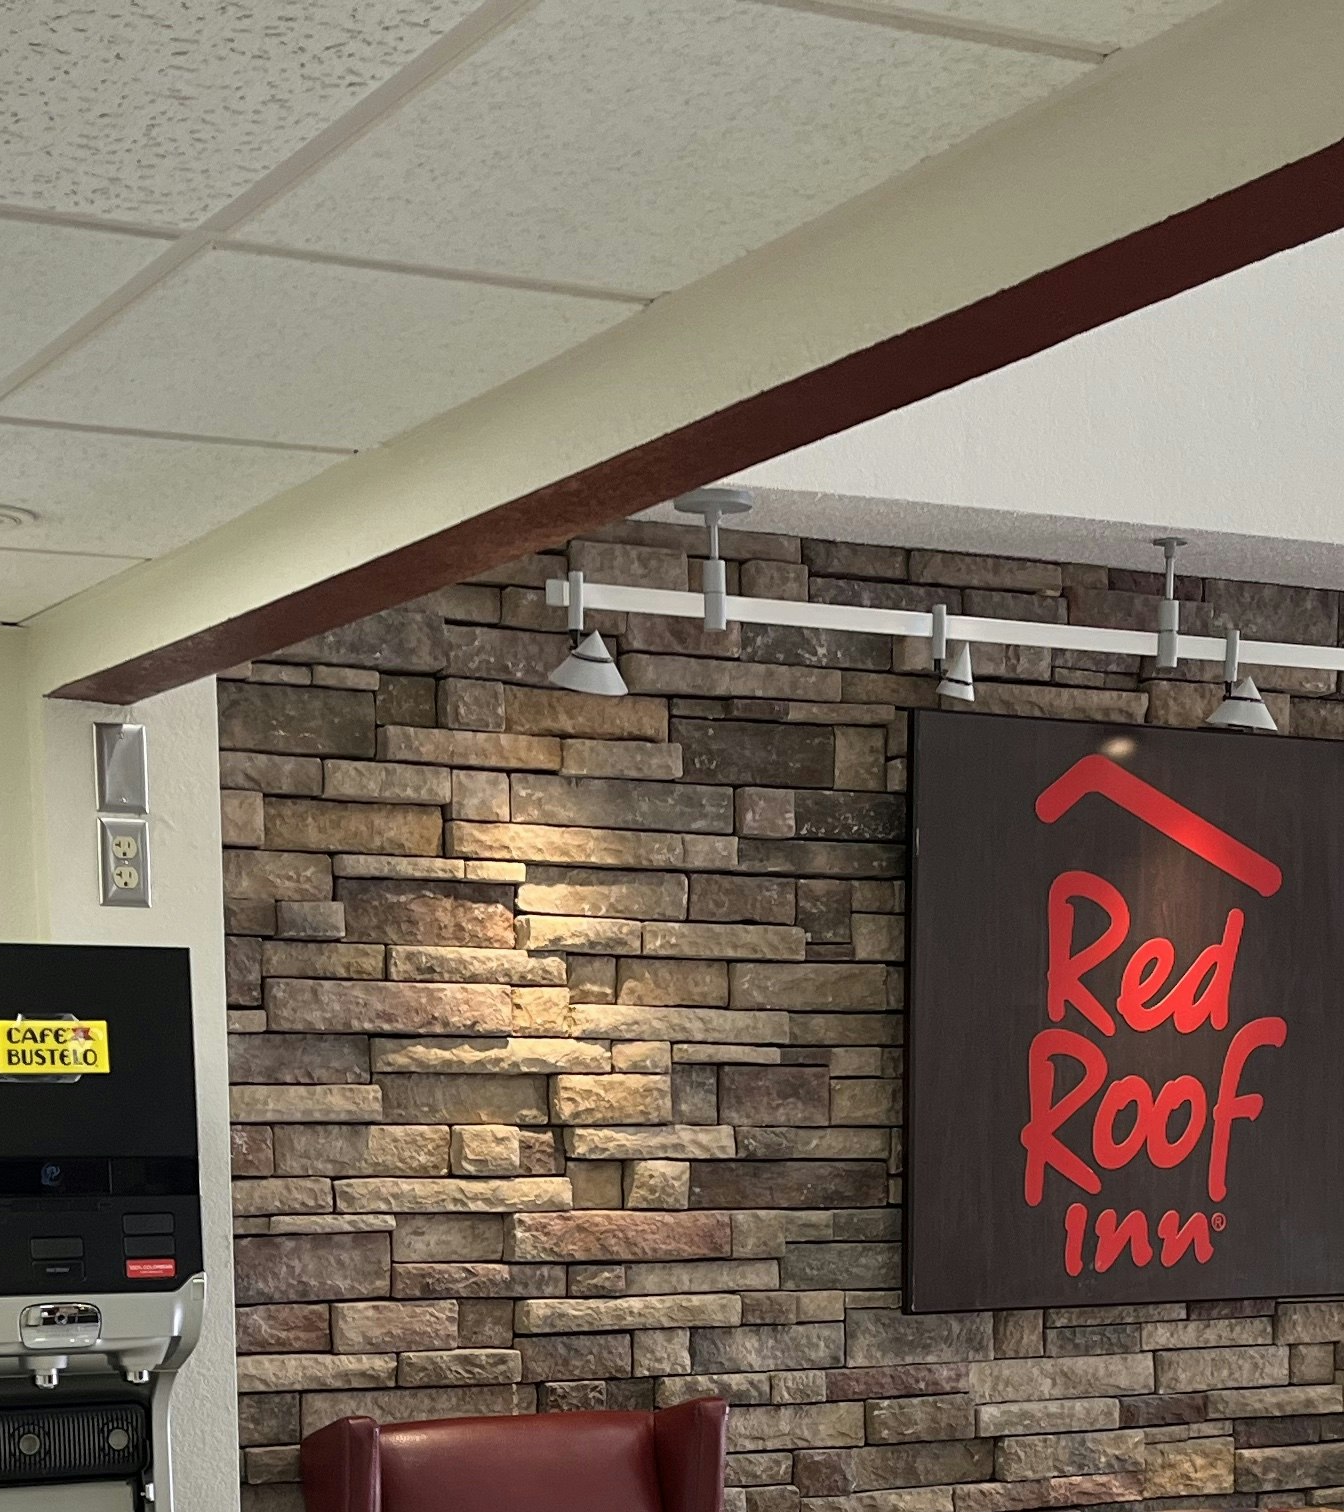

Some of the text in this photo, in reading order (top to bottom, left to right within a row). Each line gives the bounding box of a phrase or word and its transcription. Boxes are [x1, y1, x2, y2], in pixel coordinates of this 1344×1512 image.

[1047, 870, 1245, 1037] Red
[6, 1048, 99, 1067] BUSTELO
[1020, 1016, 1288, 1207] Roof
